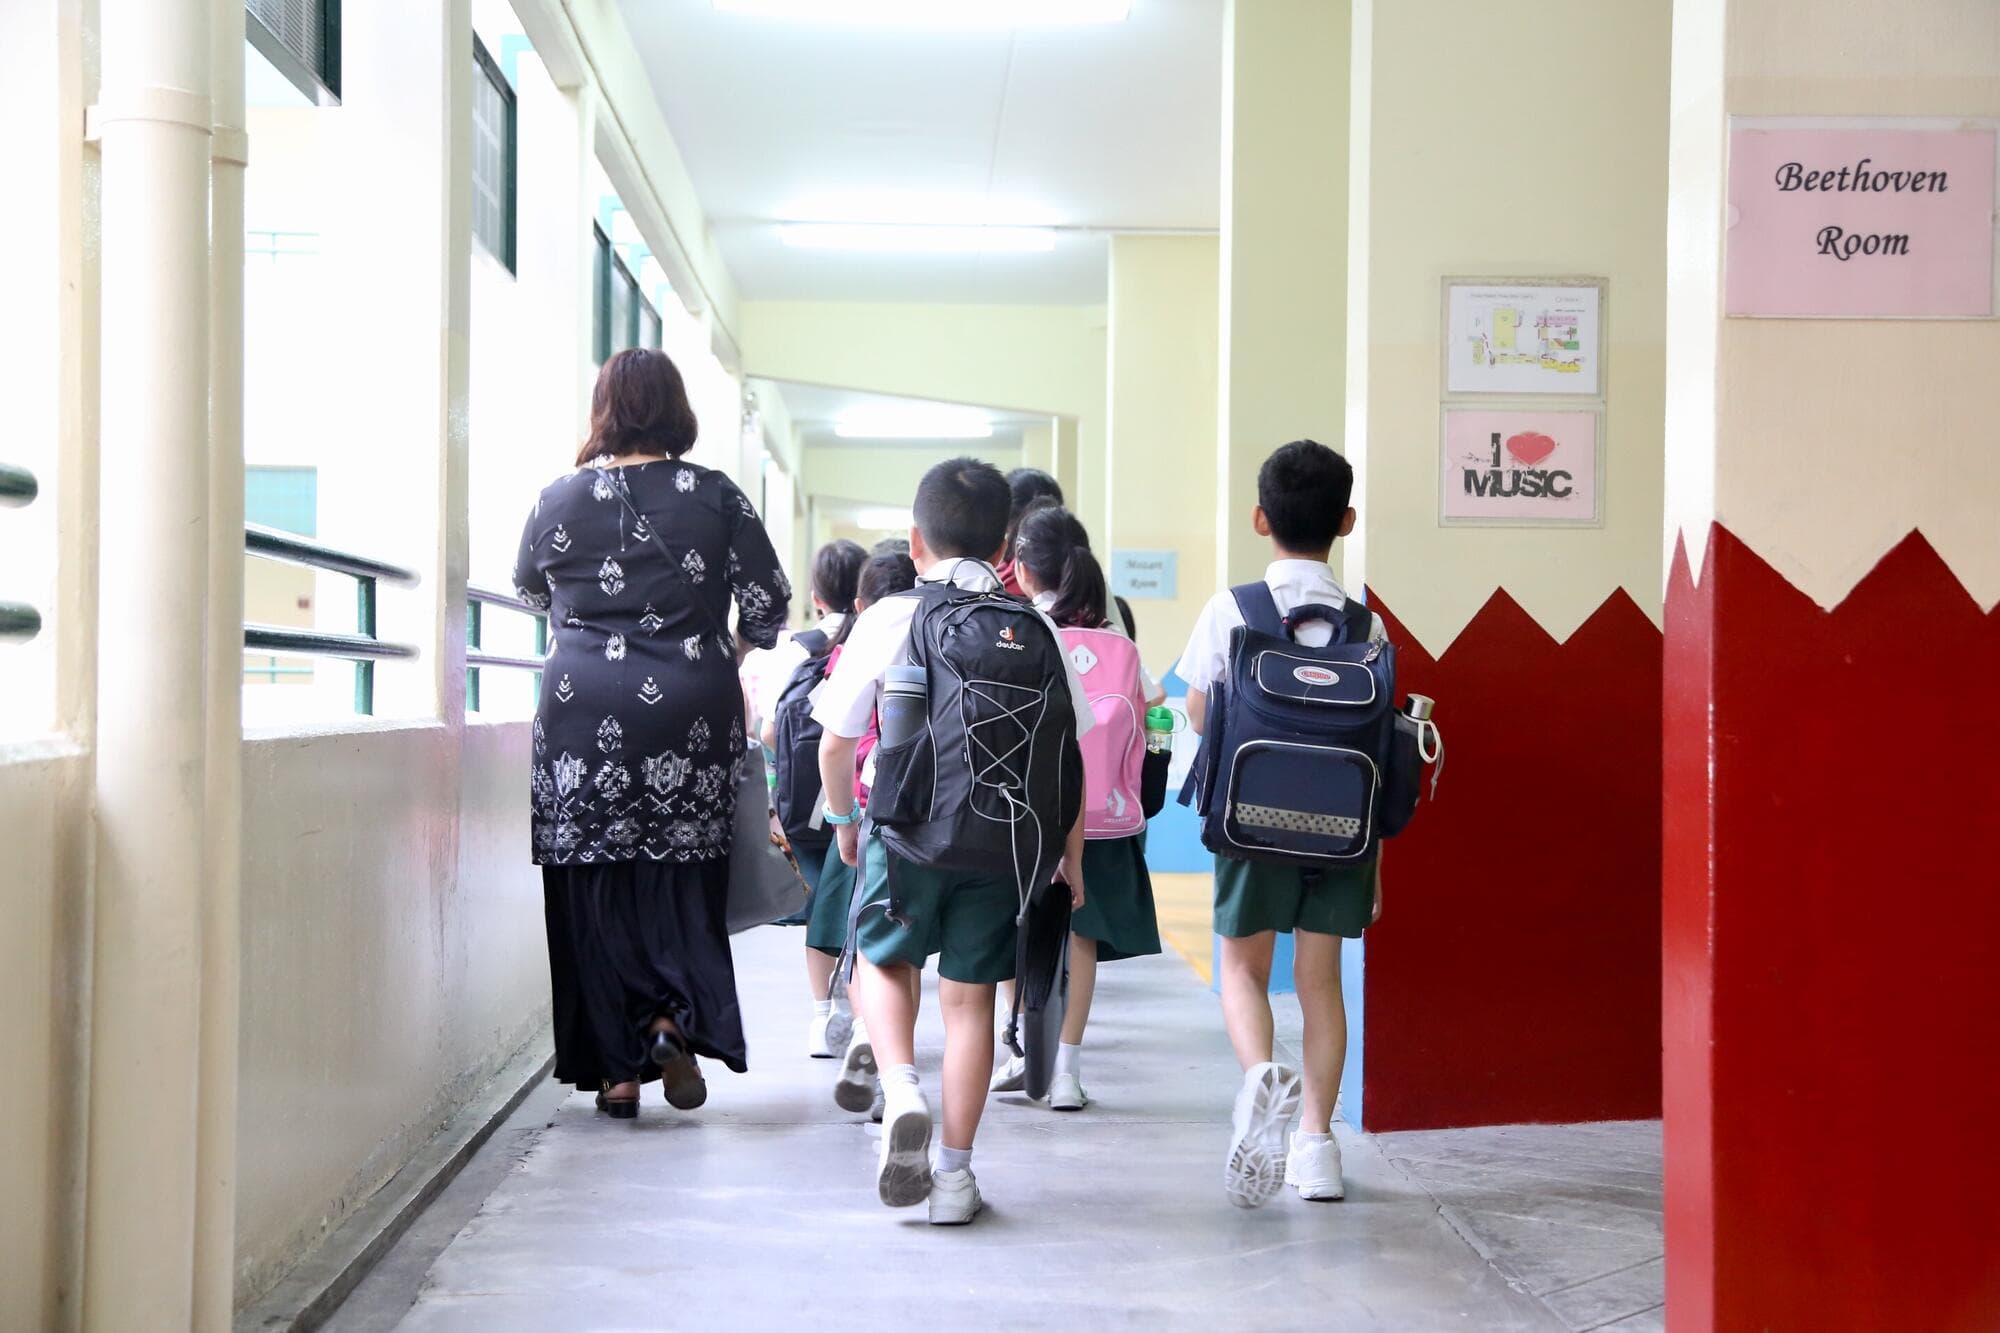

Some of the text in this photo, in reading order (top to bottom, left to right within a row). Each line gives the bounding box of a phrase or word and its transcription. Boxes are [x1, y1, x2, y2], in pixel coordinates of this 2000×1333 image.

[1775, 158, 1948, 193] Beethoven
[1816, 226, 1909, 261] Room
[1490, 432, 1502, 468] I
[1464, 468, 1573, 498] MUSIC
[996, 641, 1025, 651] deuter
